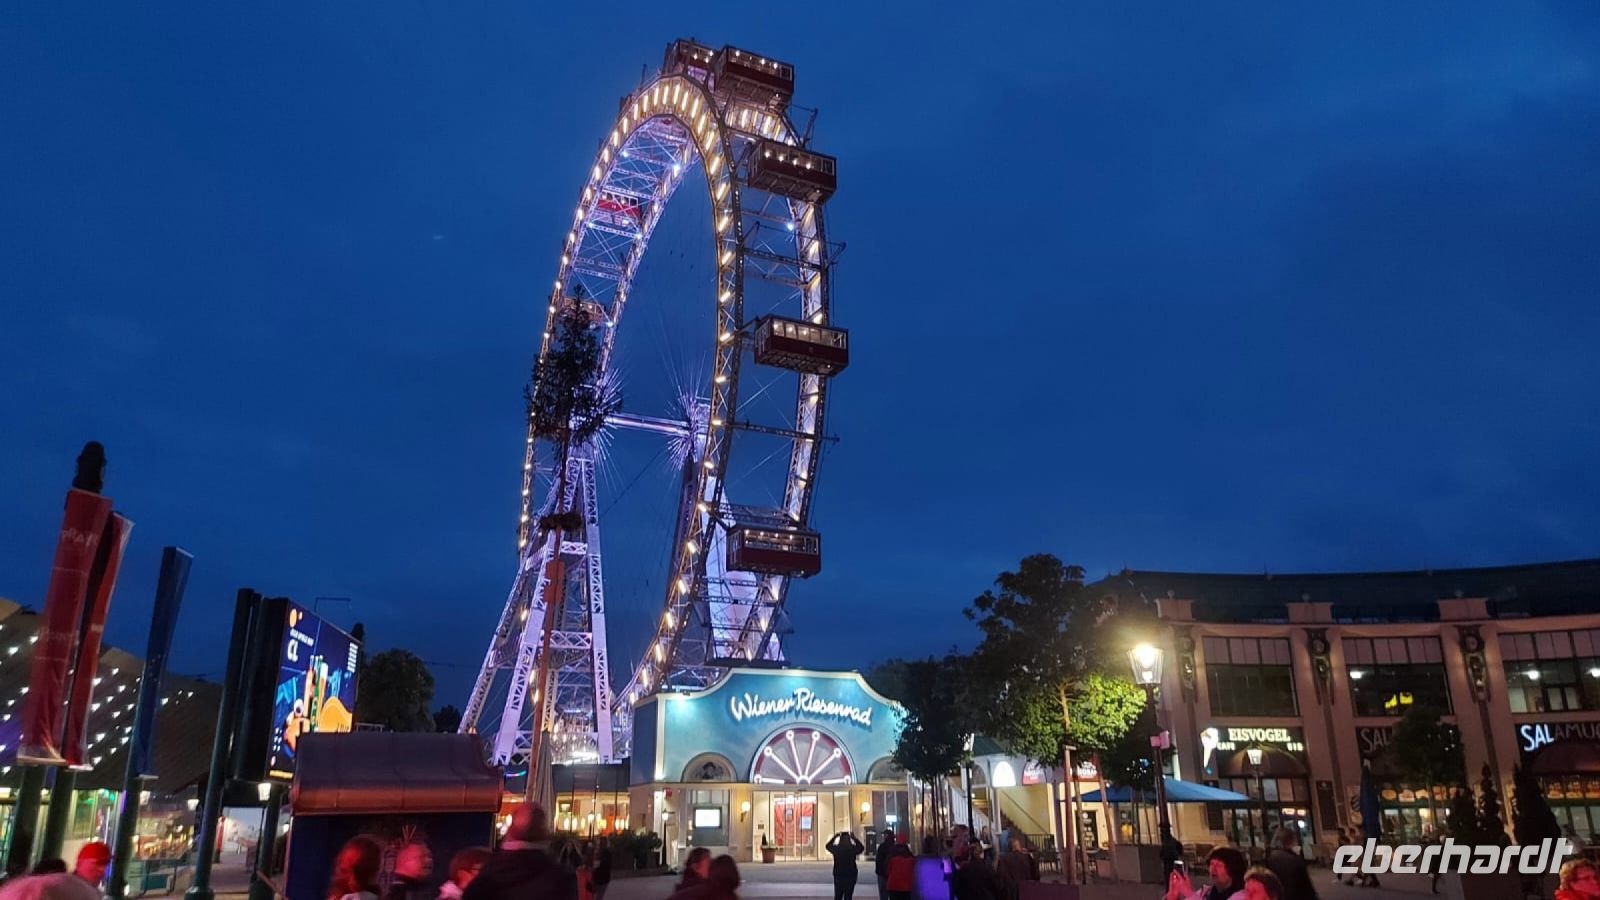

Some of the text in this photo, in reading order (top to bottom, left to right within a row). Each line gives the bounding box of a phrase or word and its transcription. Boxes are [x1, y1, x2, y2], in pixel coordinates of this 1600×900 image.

[731, 687, 873, 726] Wiener Riesenrad
[1228, 728, 1291, 741] EISVOGEL
